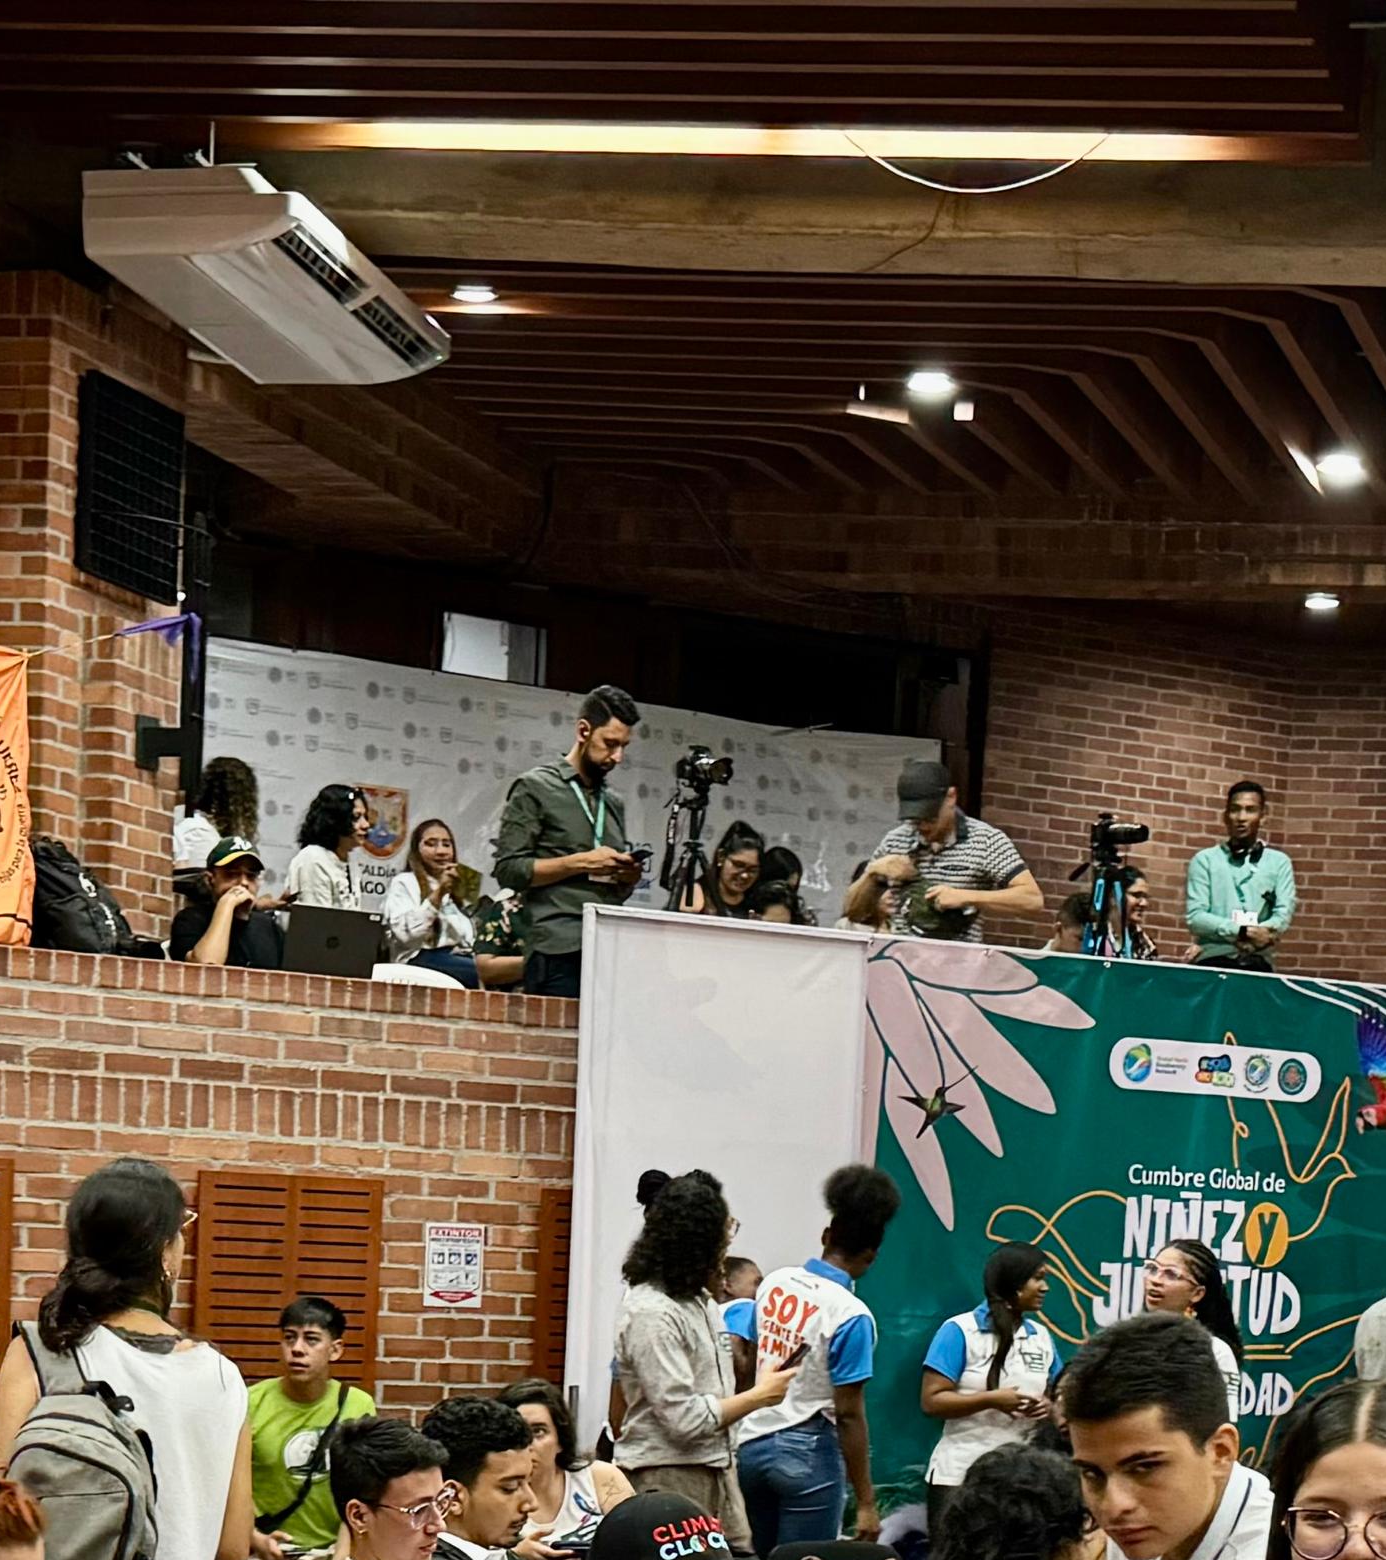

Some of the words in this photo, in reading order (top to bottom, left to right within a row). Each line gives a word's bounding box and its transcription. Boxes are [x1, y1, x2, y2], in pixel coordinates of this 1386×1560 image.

[1128, 1163, 1206, 1188] Cumbre
[1209, 1168, 1260, 1192] Global
[1262, 1172, 1286, 1193] de
[1122, 1191, 1246, 1263] NIÑEZ
[762, 1286, 819, 1333] SOY
